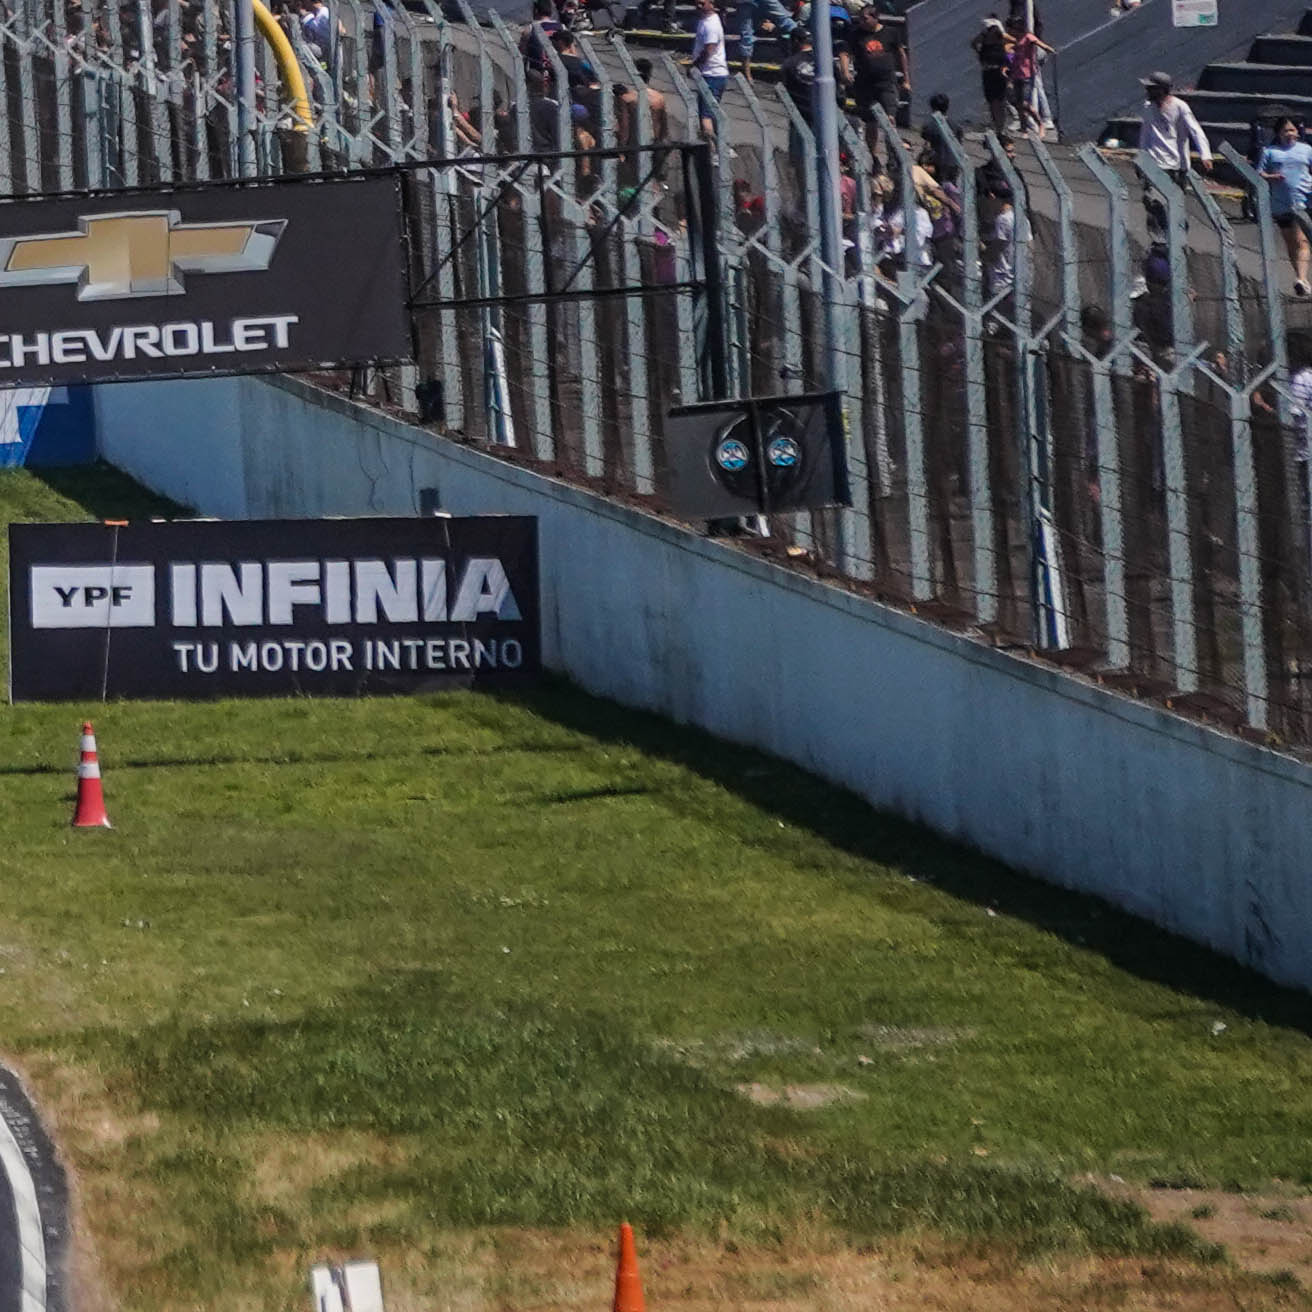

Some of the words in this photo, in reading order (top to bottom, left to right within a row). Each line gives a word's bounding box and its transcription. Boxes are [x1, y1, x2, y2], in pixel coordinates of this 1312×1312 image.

[52, 584, 134, 609] YPF
[171, 556, 522, 628] INFINIA
[172, 643, 219, 674] TU
[231, 640, 352, 673] MOTOR
[365, 639, 523, 671] INTERNO
